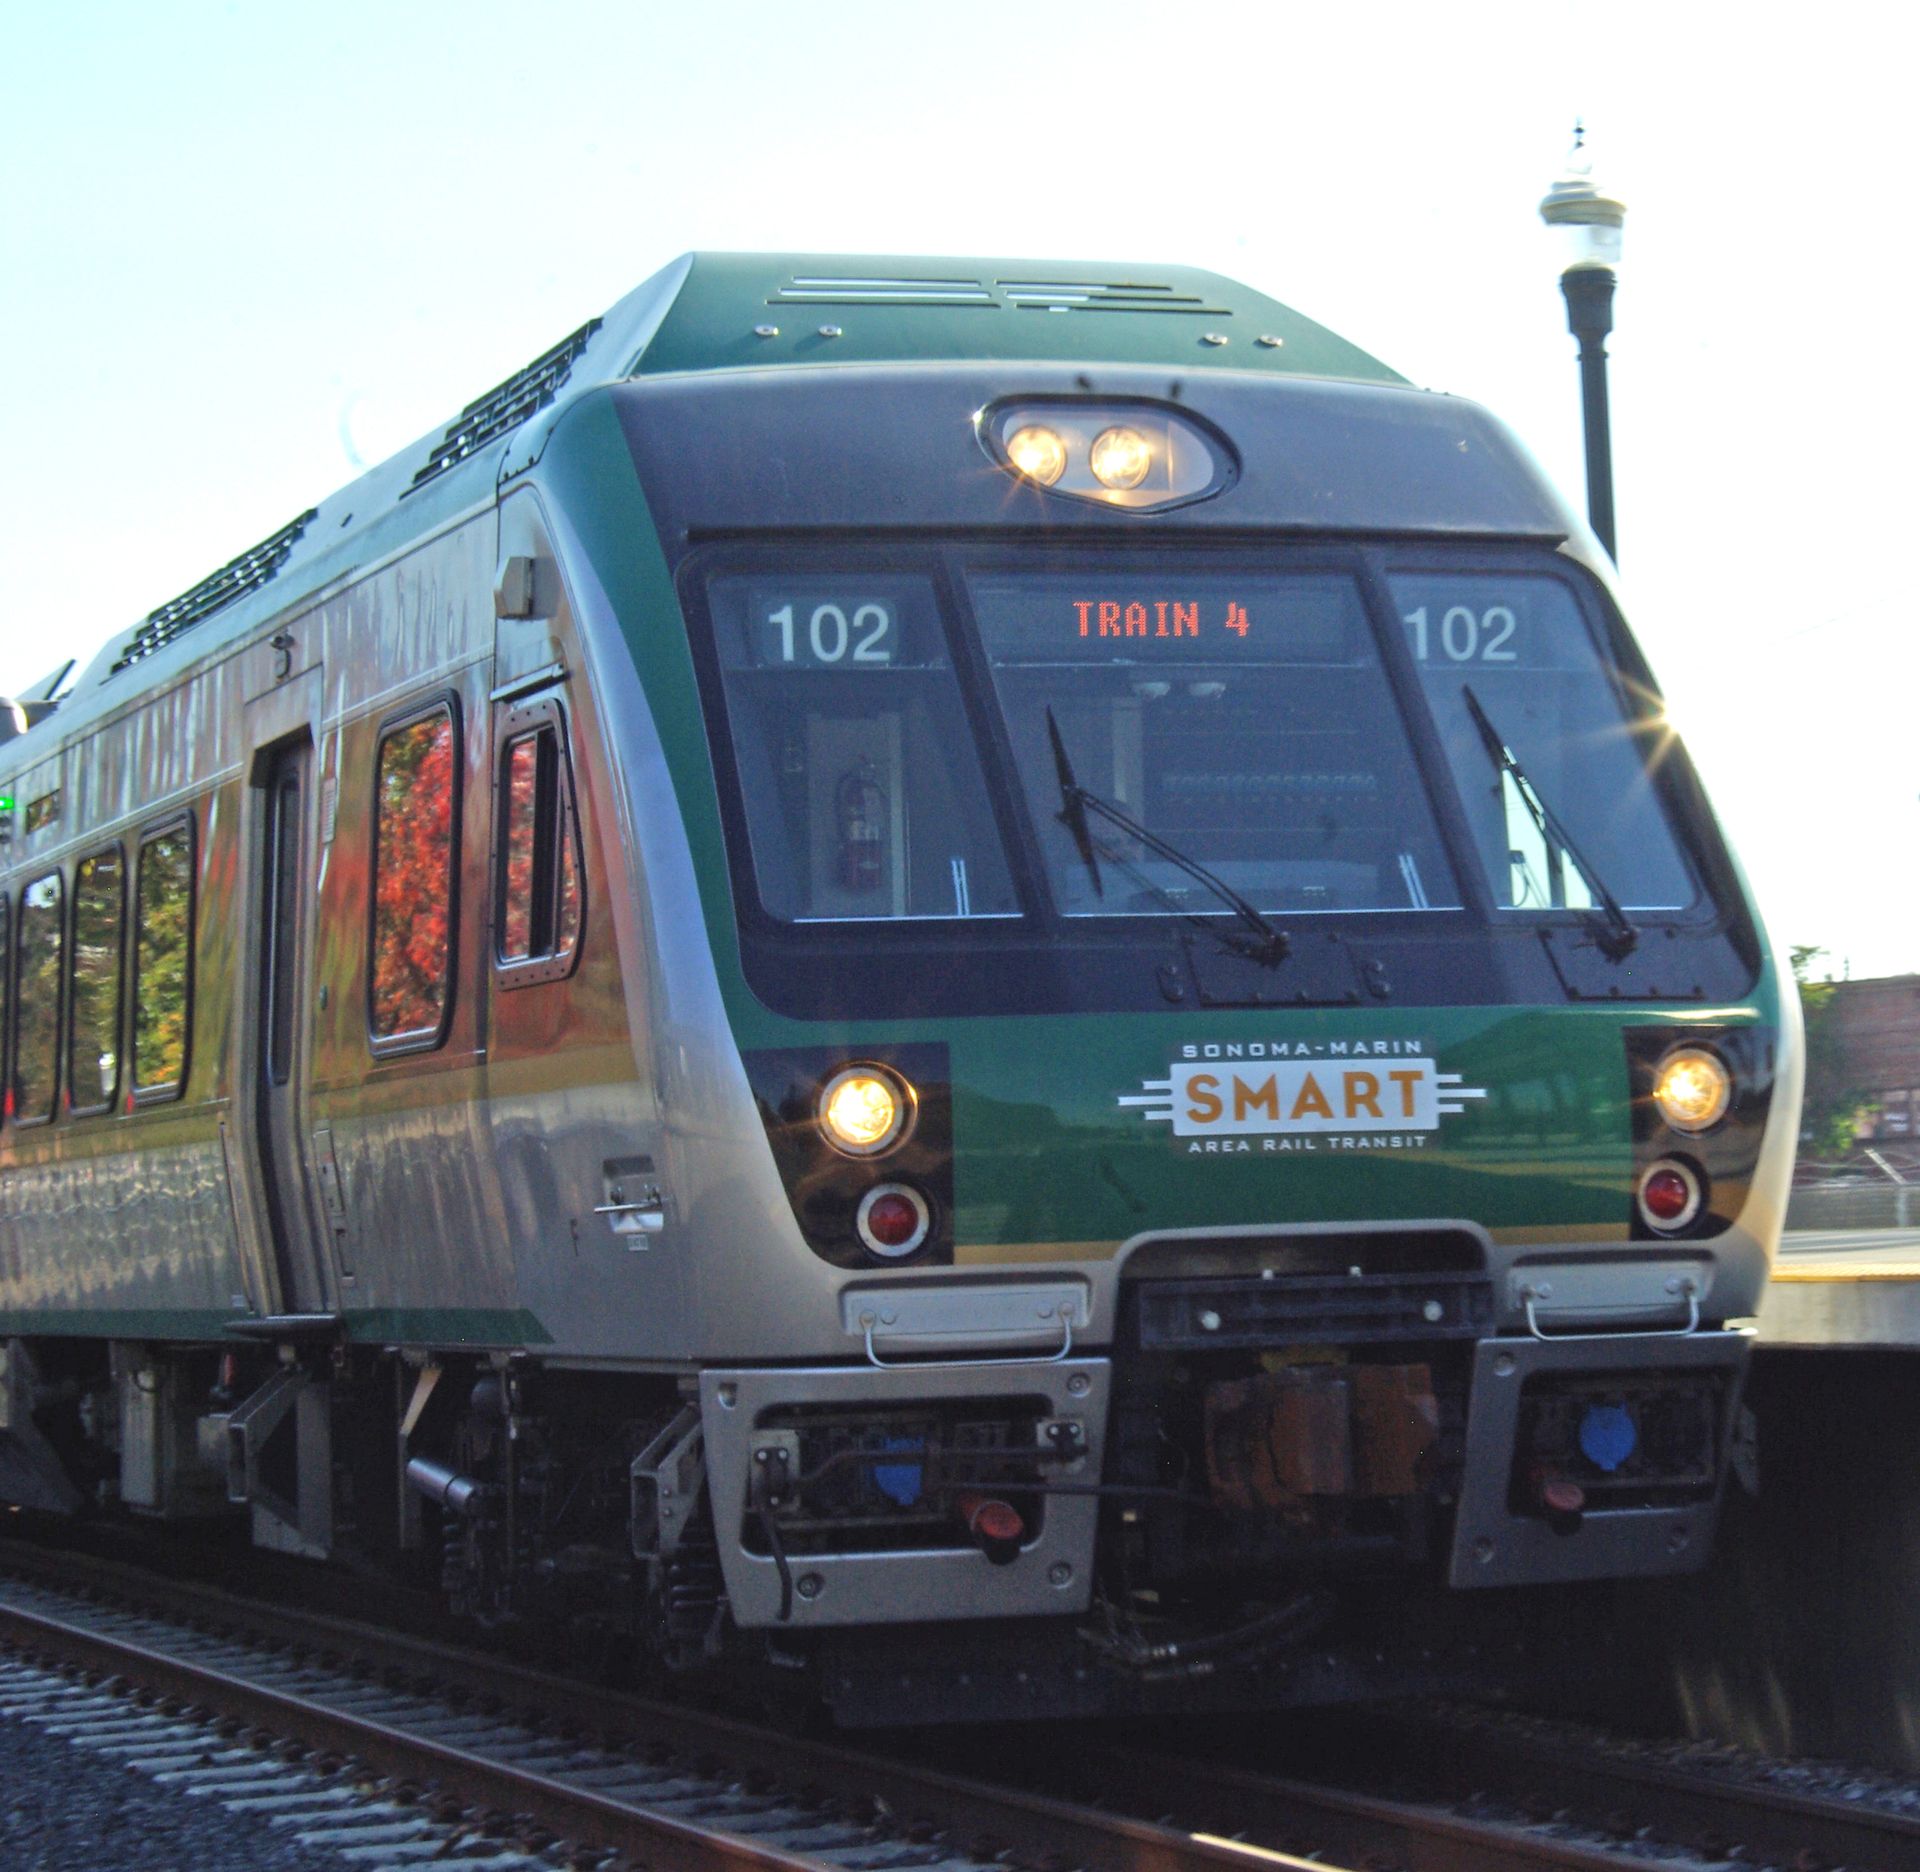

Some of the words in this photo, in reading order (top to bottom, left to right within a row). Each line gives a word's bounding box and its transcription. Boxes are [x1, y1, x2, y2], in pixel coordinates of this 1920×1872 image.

[768, 605, 891, 662] 102
[1072, 601, 1199, 637] TRAIN
[1226, 601, 1250, 637] 4
[1403, 606, 1517, 661] 102
[1182, 1040, 1422, 1058] SONOMA-MARIN
[1186, 1070, 1424, 1123] SMART
[1188, 1140, 1250, 1153] AREA
[1263, 1138, 1316, 1150] RAIL
[1328, 1135, 1426, 1149] TRANSIT
